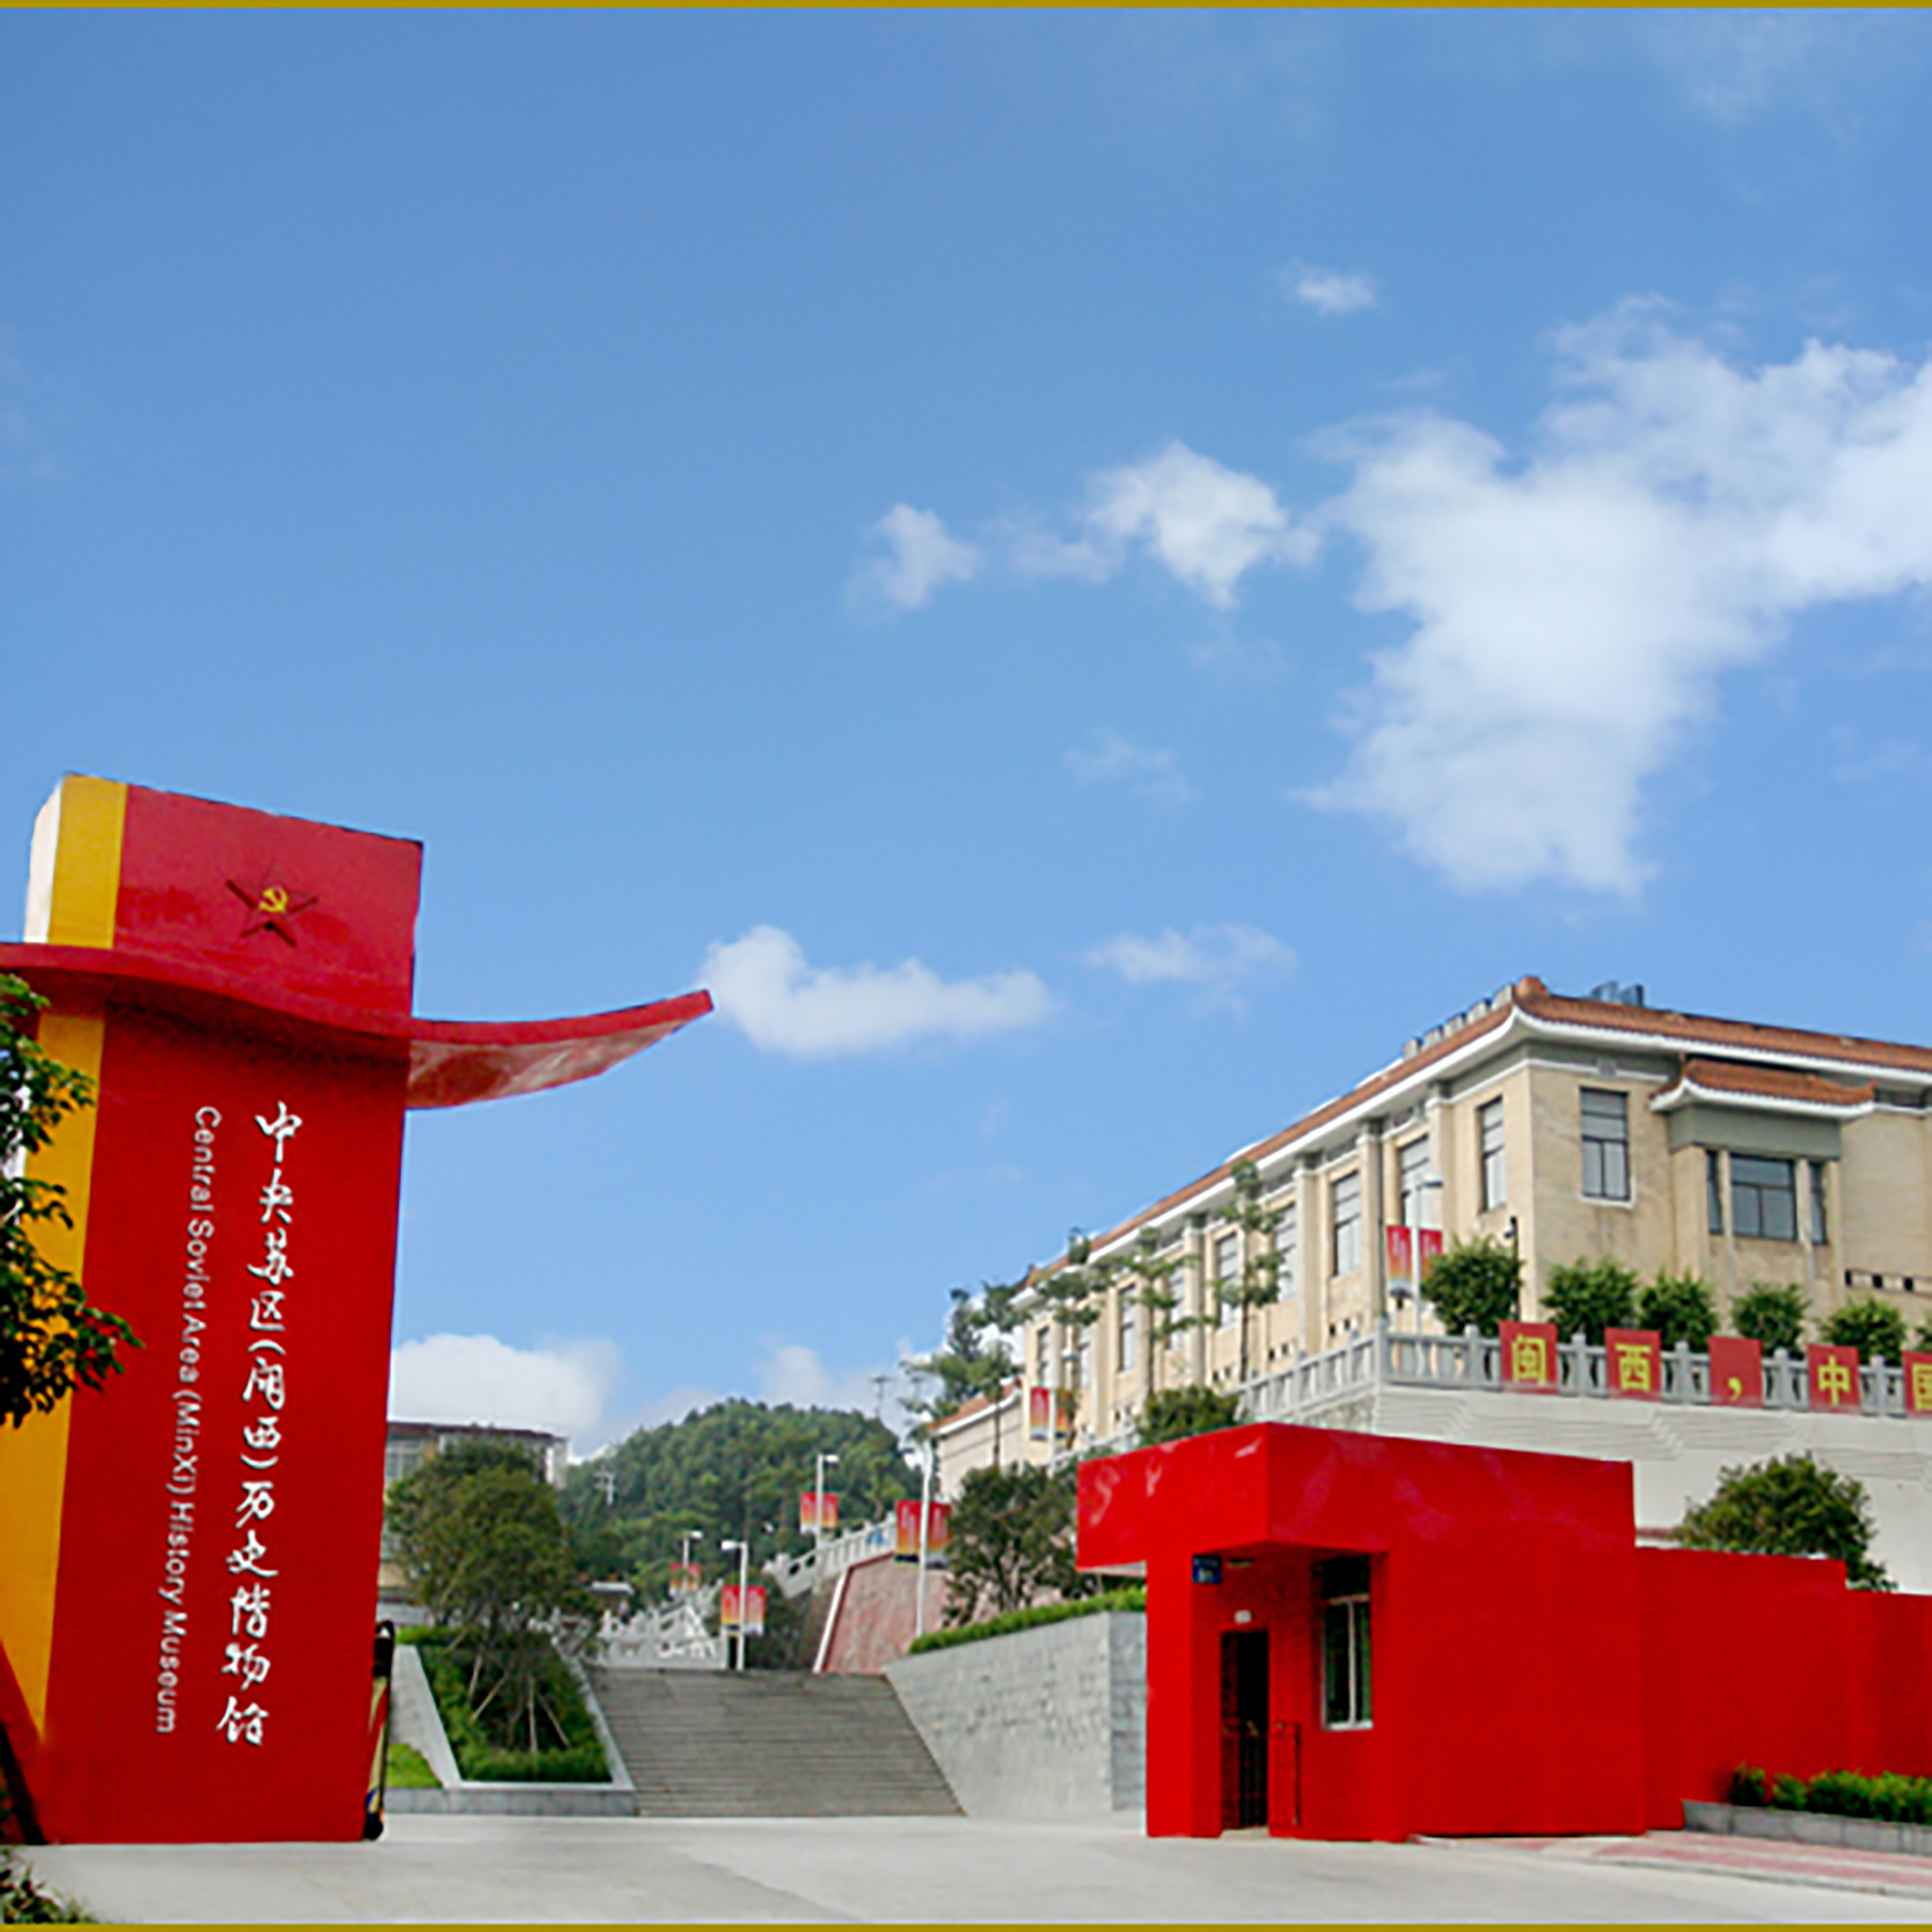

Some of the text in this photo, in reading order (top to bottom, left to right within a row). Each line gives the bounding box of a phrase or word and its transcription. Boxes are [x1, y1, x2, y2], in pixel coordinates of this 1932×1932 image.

[190, 1105, 222, 1212] Central
[183, 1218, 214, 1310] Soviet
[179, 1314, 207, 1383] Area
[158, 1501, 195, 1605] History
[156, 1610, 187, 1733] Museum
